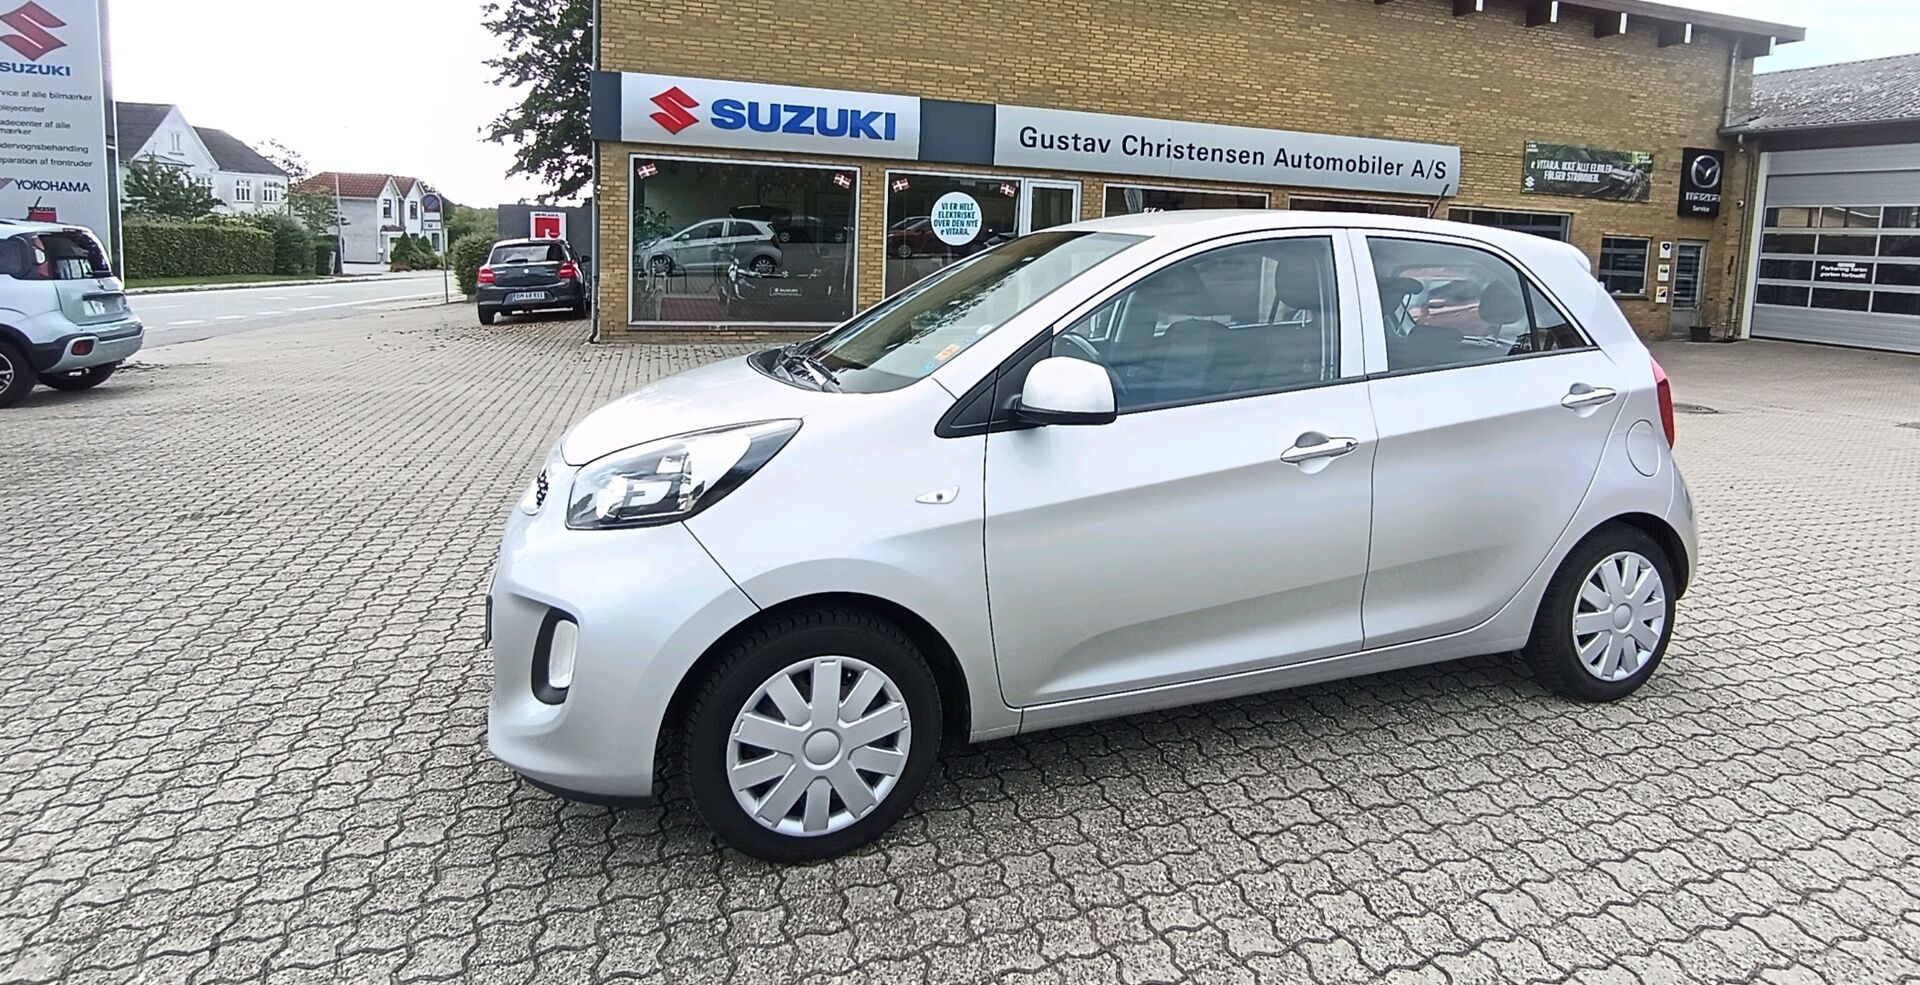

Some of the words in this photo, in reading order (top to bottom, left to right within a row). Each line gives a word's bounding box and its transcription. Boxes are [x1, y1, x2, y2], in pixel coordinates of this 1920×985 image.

[0, 62, 71, 76] SUZUKI
[49, 92, 93, 101] bilmærker
[711, 98, 896, 142] SUZUKI
[55, 121, 71, 129] alle
[1019, 126, 1112, 154] Gustav
[1121, 134, 1266, 167] Christensen
[1273, 147, 1404, 177] Automobiler
[1410, 159, 1448, 181] A/S
[40, 158, 49, 166] af
[50, 159, 93, 168] frontruder
[1561, 161, 1576, 171] IKKE
[15, 179, 91, 193] YOKOHAMA
[941, 202, 949, 210] VI
[950, 202, 958, 210] ER
[959, 203, 974, 211] HELT
[938, 211, 976, 219] ELEKTRISKE
[933, 219, 951, 227] OVER
[966, 220, 979, 228] NYE
[945, 228, 970, 236] VITARA.
